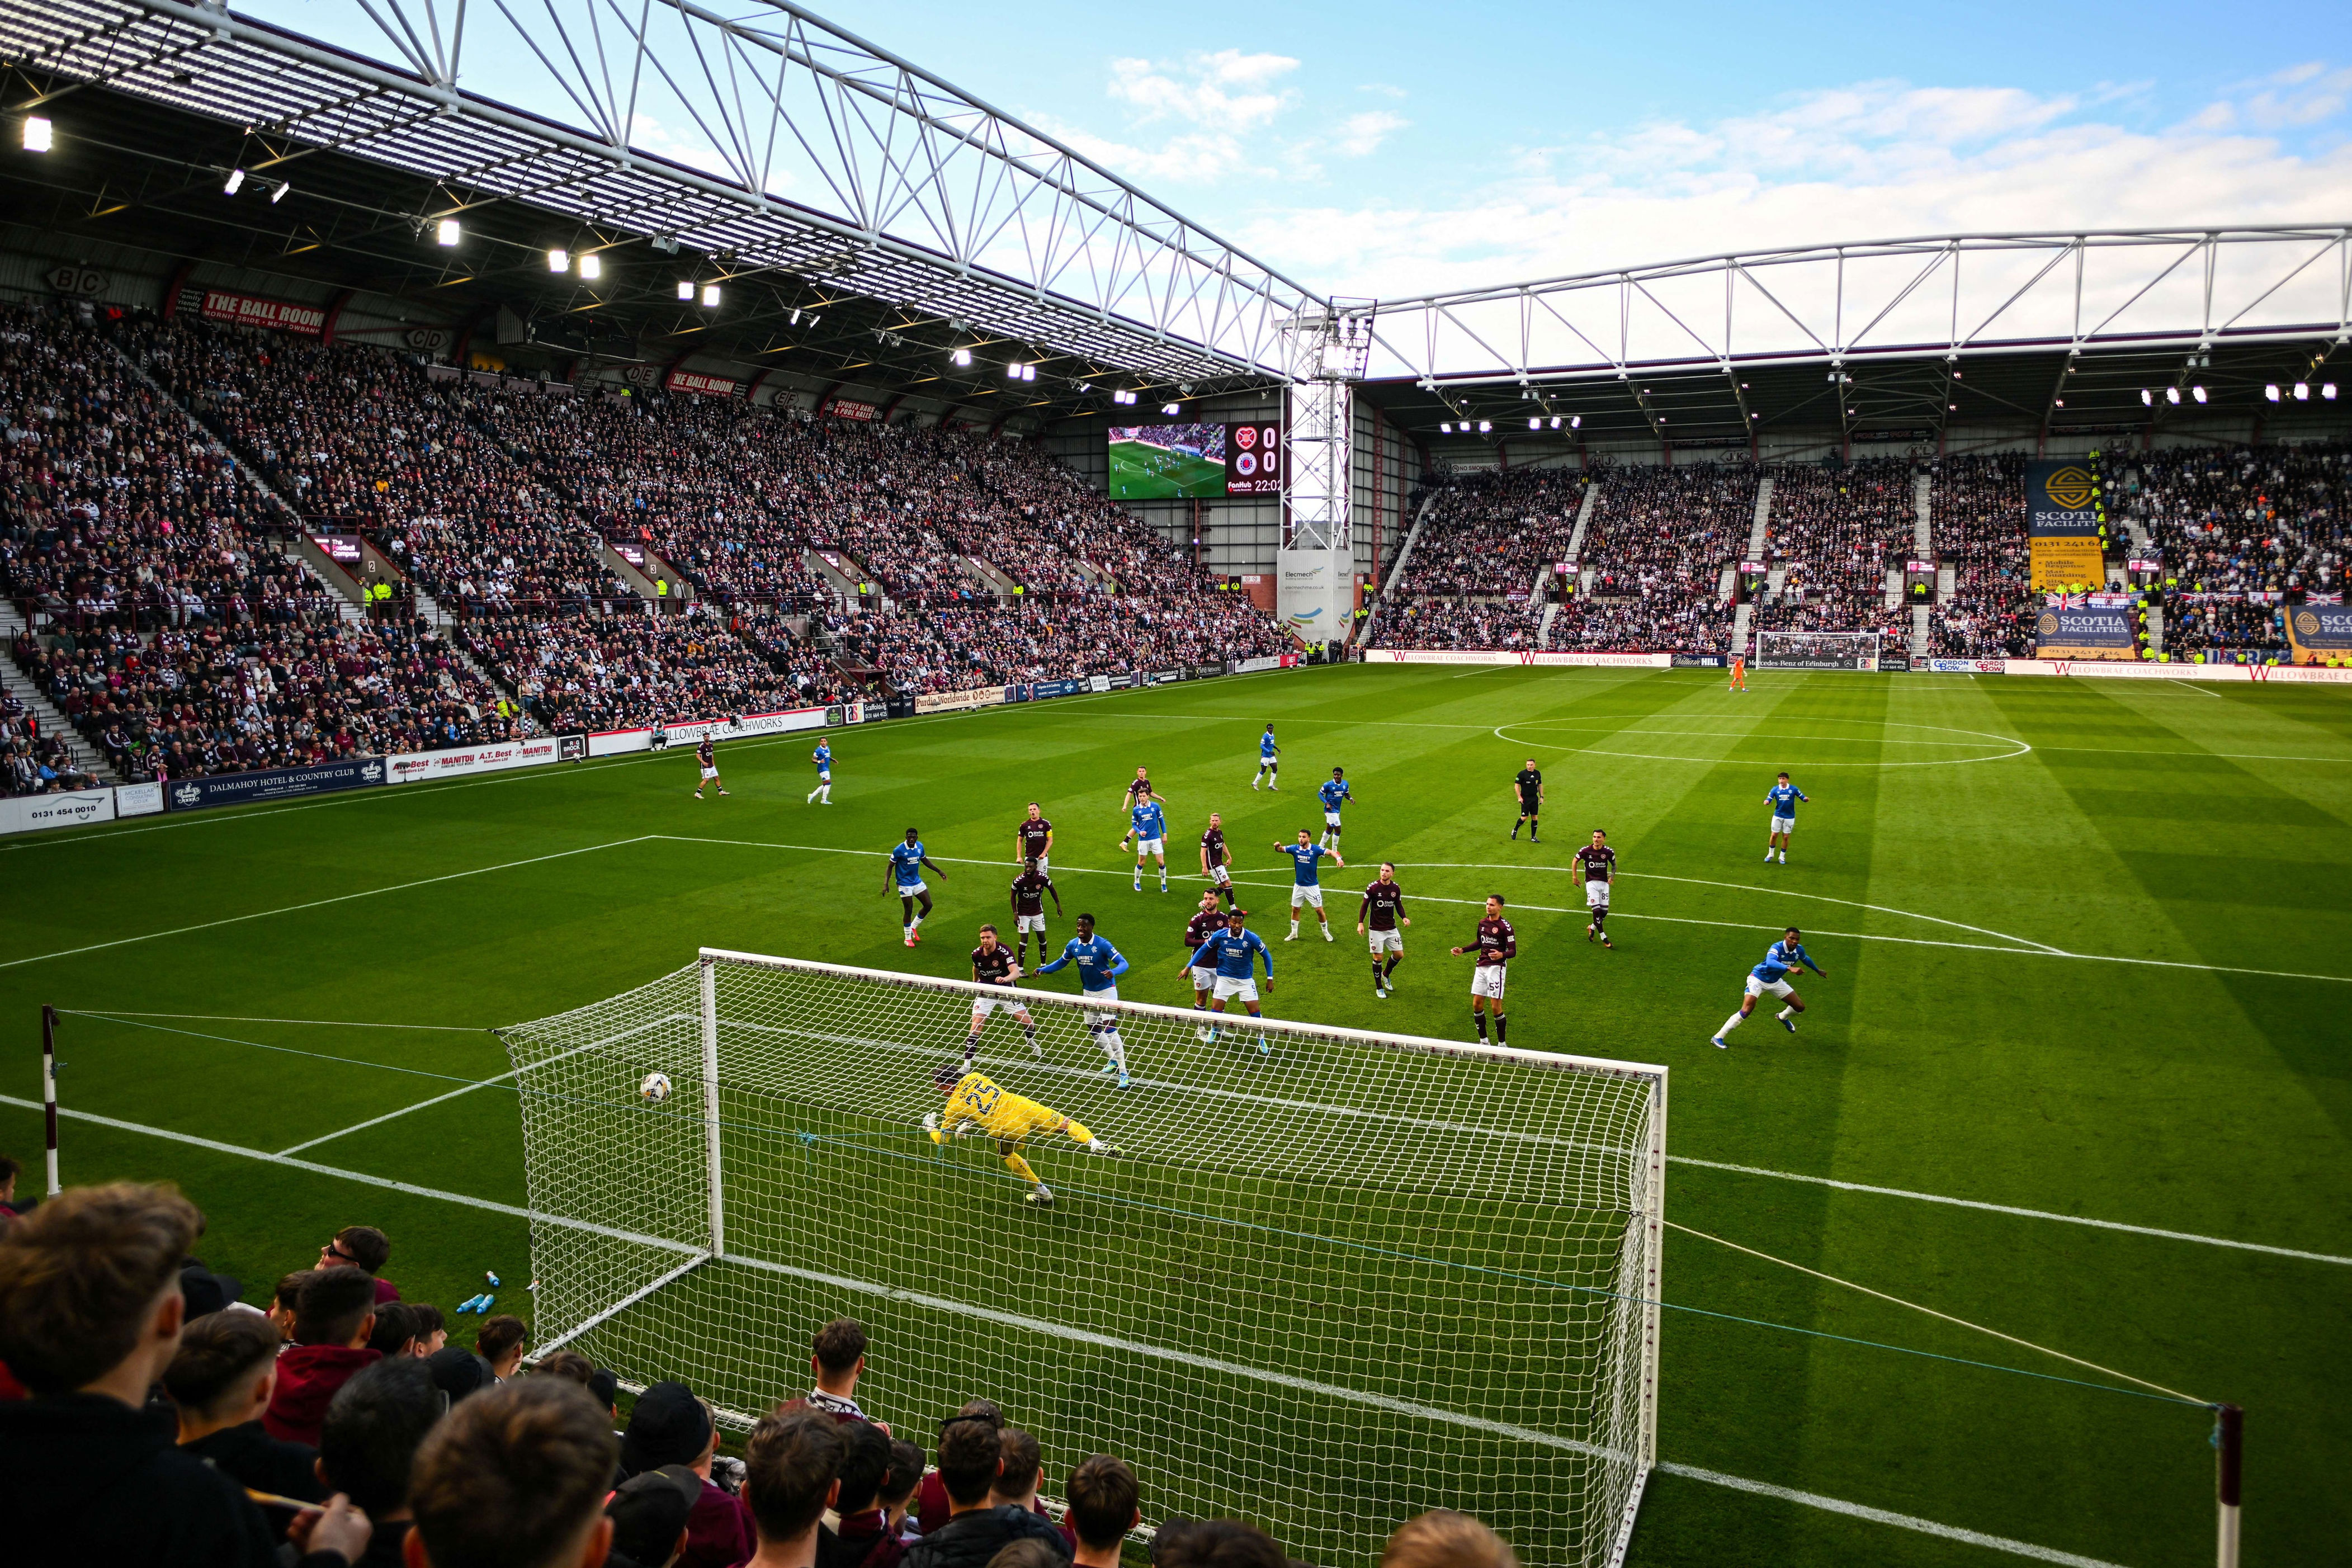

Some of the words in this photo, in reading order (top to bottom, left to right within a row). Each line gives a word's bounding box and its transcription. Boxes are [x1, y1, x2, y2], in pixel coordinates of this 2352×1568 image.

[58, 270, 73, 287] B
[83, 275, 98, 291] C
[207, 293, 239, 313] THE
[239, 299, 276, 319] BALL
[278, 306, 325, 327] ROOM
[414, 332, 424, 346] C
[429, 333, 441, 346] D
[631, 369, 640, 379] D
[642, 370, 653, 381] E
[686, 375, 707, 389] BALL
[707, 379, 734, 393] ROOM
[778, 393, 786, 403] E
[787, 393, 795, 403] F
[837, 400, 859, 410] SPORTS
[1263, 427, 1276, 448] 0
[1737, 452, 1744, 461] K
[1911, 447, 1918, 455] K
[1263, 451, 1276, 472] 0
[1255, 480, 1281, 491] 22:02
[2035, 511, 2098, 521] SCOTI
[370, 563, 374, 571] 2
[2060, 616, 2124, 626] SCOTIA
[1394, 651, 1444, 662] WILLOWBRAE
[1520, 651, 1584, 665] WILLOWBRAE
[1587, 655, 1652, 664] COACHWORKS
[1671, 656, 1702, 667] William
[1701, 658, 1718, 666] HILL
[1246, 658, 1271, 667] EDINBURGH
[1806, 659, 1839, 667] Edinburgh
[1934, 660, 1969, 668] GORDON
[2055, 662, 2124, 676] WILLOWBRAE
[2127, 666, 2198, 676] COACHWORKS
[2249, 665, 2342, 681] WILLOWBRAE
[916, 696, 936, 707] Purdie
[938, 692, 970, 705] Worldwide
[865, 702, 887, 711] Scaffolding
[667, 724, 720, 741] ILLOWBRAE
[522, 745, 552, 755] MANITOU
[410, 759, 429, 768] Best
[441, 755, 475, 765] MANITOU
[210, 780, 258, 792] DALMAHOY
[261, 777, 287, 786] HOTEL
[296, 771, 333, 782] COUNTRY
[335, 768, 355, 777] CLUB
[125, 788, 154, 796] MCKELLAR
[966, 1080, 1000, 1115] 25
